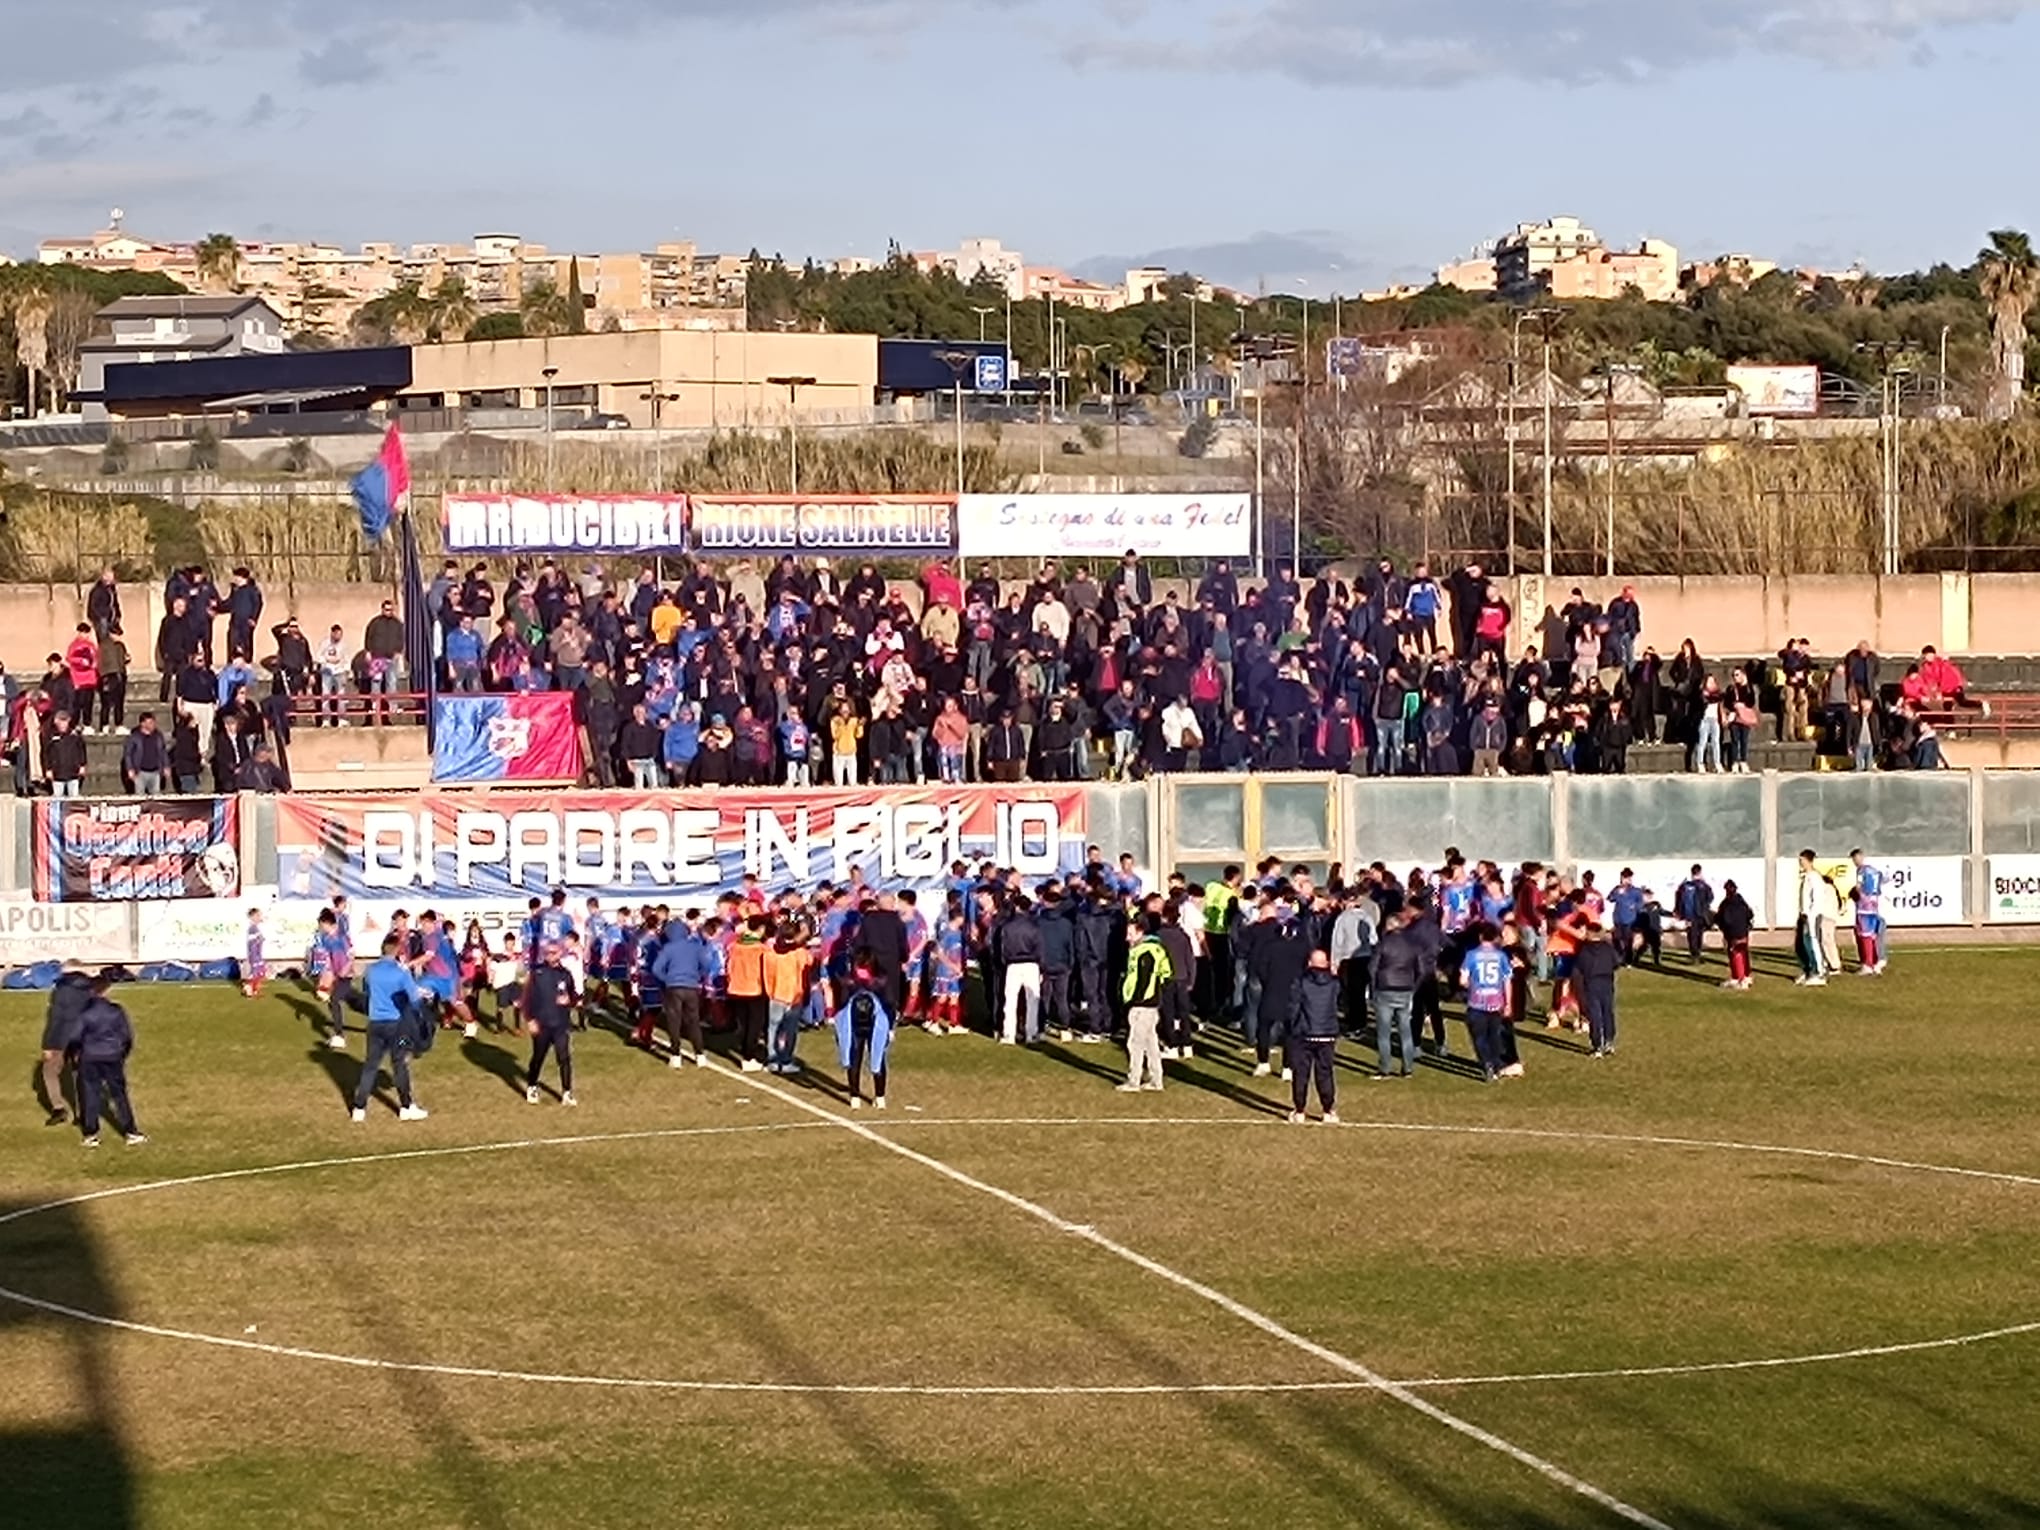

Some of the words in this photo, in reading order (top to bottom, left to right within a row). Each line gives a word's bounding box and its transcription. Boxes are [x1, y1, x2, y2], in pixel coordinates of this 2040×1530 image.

[702, 504, 796, 547] RIONE
[799, 504, 951, 547] SALINELLE
[363, 811, 434, 887] DI
[456, 809, 721, 887] PADRE
[744, 806, 809, 883] IN
[833, 800, 1060, 877] FIGLIO
[1885, 890, 1942, 908] ridio
[1476, 961, 1499, 985] 15
